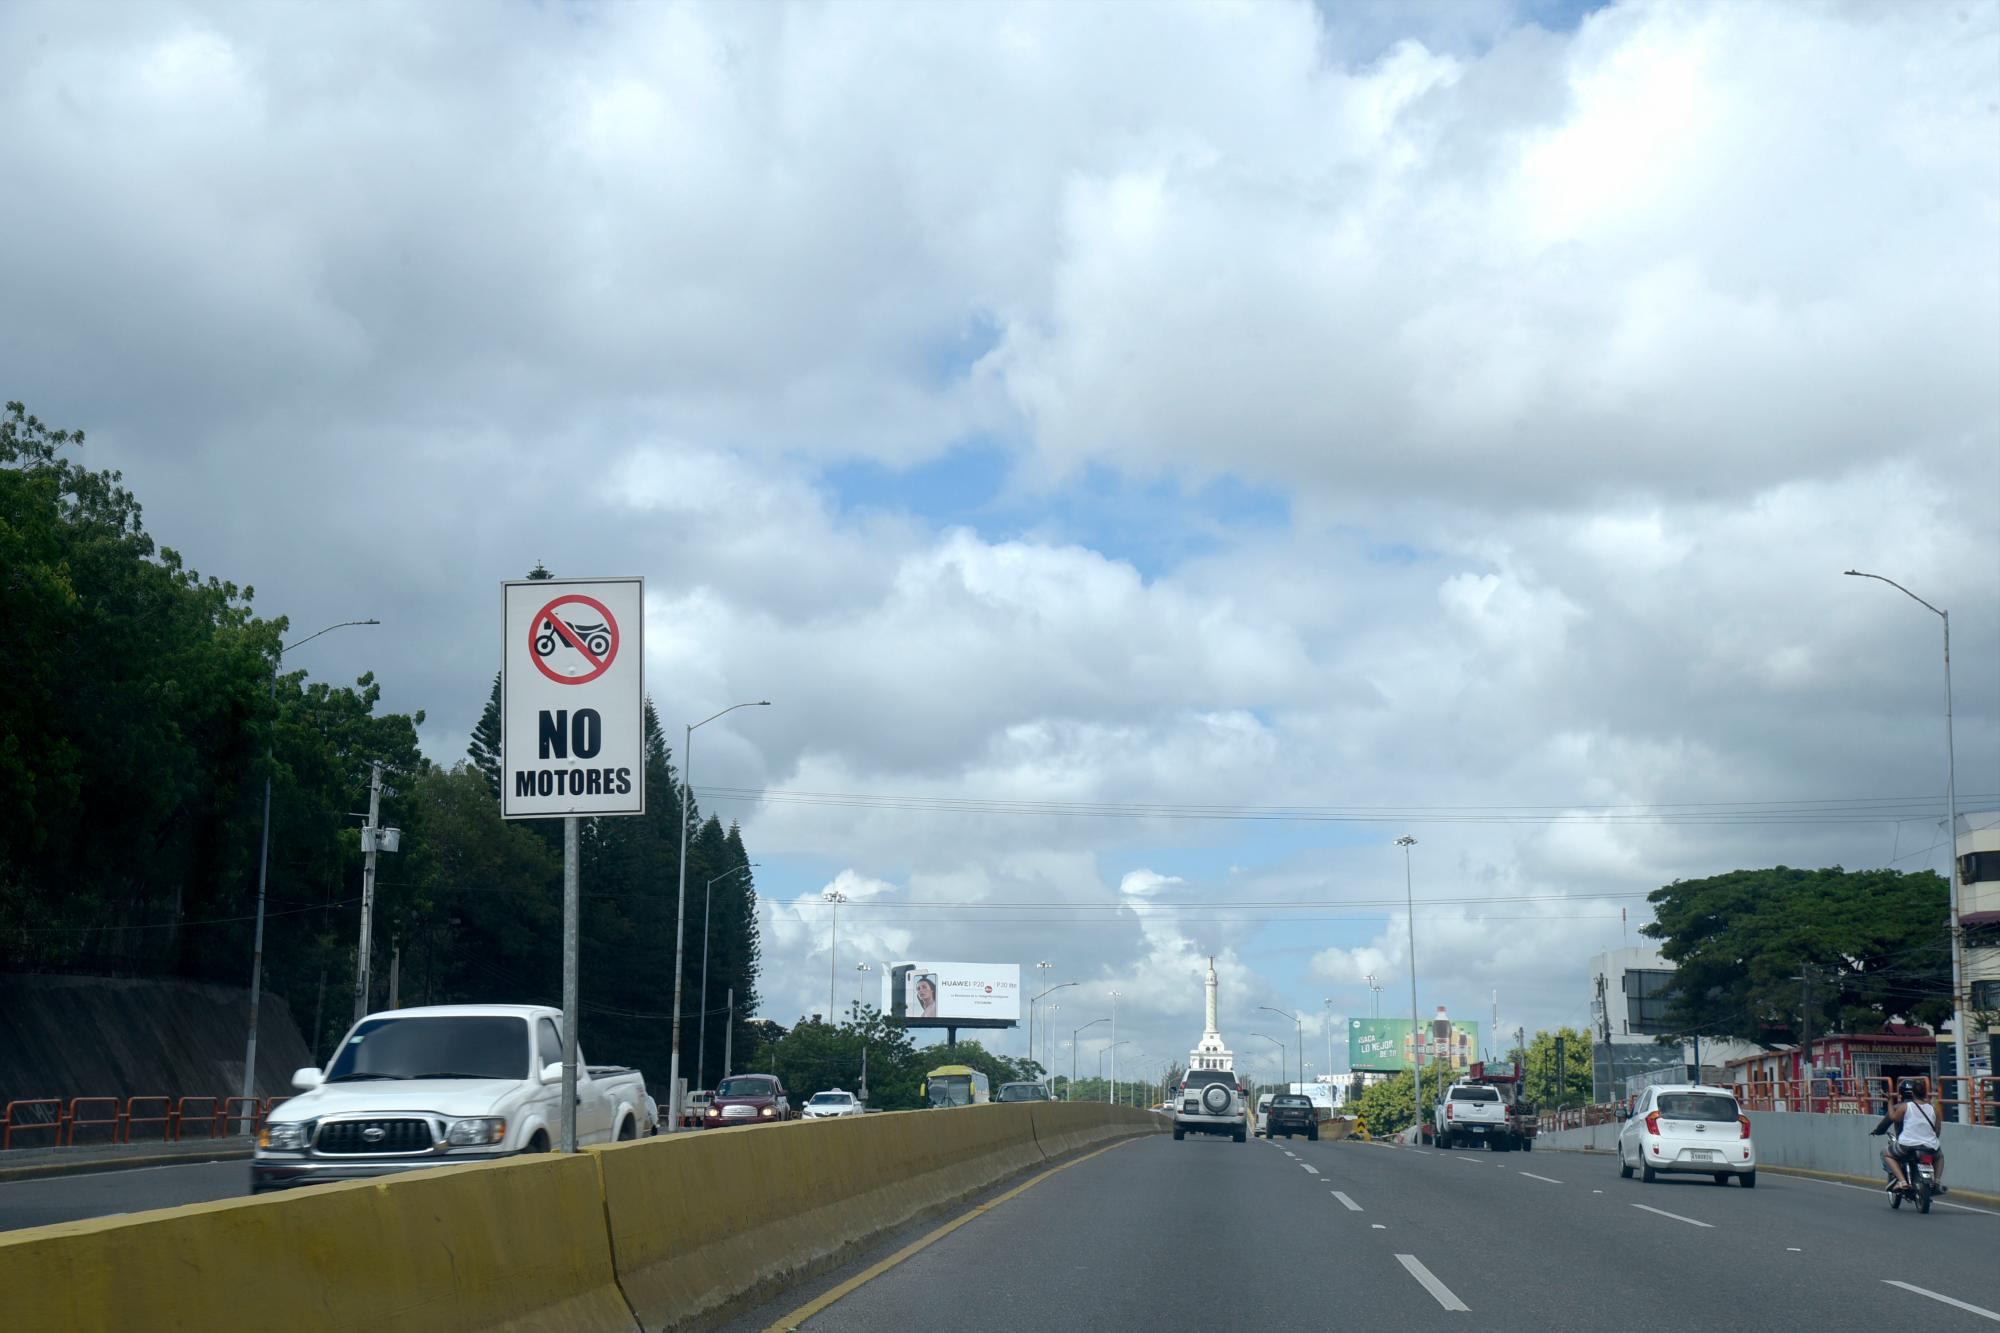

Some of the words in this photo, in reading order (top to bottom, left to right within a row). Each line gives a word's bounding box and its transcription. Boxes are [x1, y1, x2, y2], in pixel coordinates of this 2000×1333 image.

[538, 708, 602, 760] NO
[515, 767, 632, 797] MOTORES
[973, 980, 985, 988] P20
[1361, 1044, 1370, 1053] LO
[1371, 1040, 1394, 1051] MEJOR
[1848, 1044, 1870, 1052] MINI
[1871, 1045, 1909, 1053] MARKET
